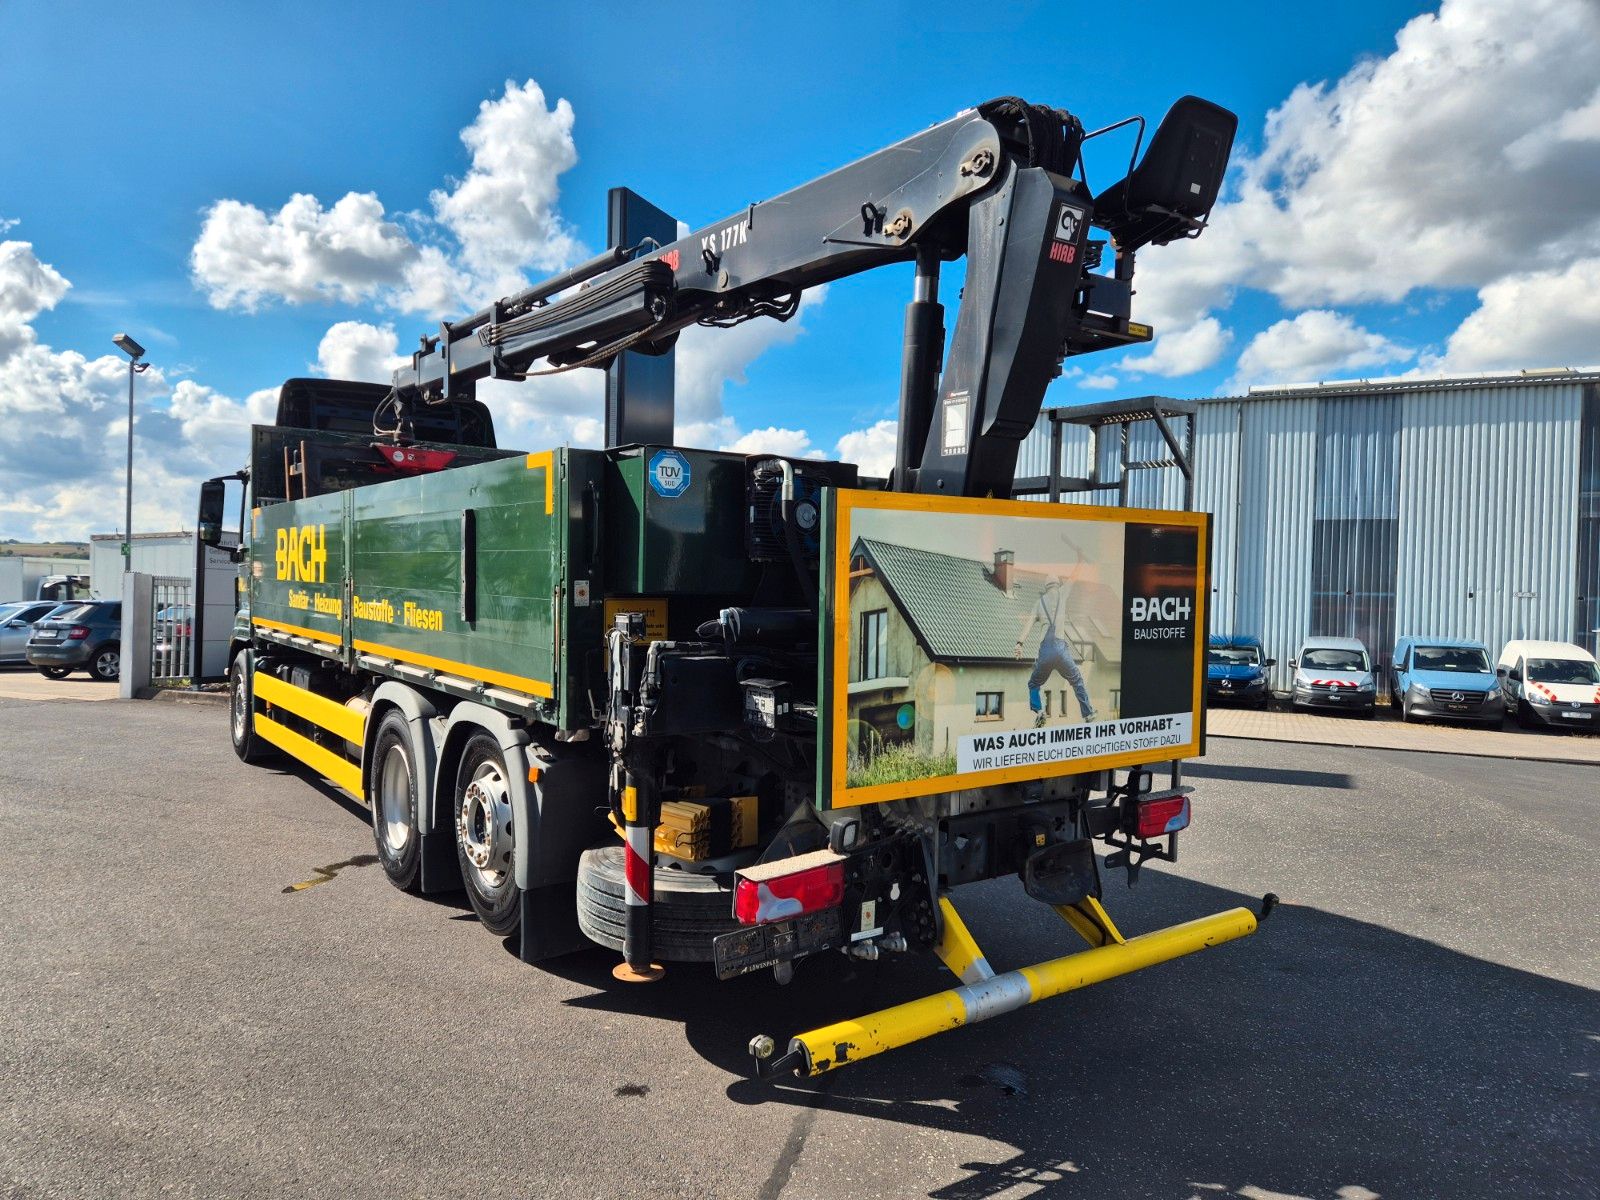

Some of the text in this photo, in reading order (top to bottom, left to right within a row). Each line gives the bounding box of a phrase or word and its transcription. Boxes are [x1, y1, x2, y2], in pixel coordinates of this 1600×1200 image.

[720, 220, 749, 252] 177K
[1050, 241, 1076, 264] HIAB
[659, 465, 681, 478] TÜV
[275, 523, 327, 583] BACH
[288, 589, 443, 632] Sanitär Heizung Baustoffe Fliesen
[1130, 597, 1191, 622] BACH
[1134, 626, 1186, 640] BAUSTOFFE
[973, 735, 1004, 753] WAS
[1008, 731, 1047, 749] AUCH
[1050, 726, 1092, 744] IMMER
[1095, 724, 1116, 738] IHR
[1119, 717, 1174, 735] VORHABT
[973, 735, 1181, 770] WIR LIEFERN EUCH DEN RICHTIGEN STOFF DAZU
